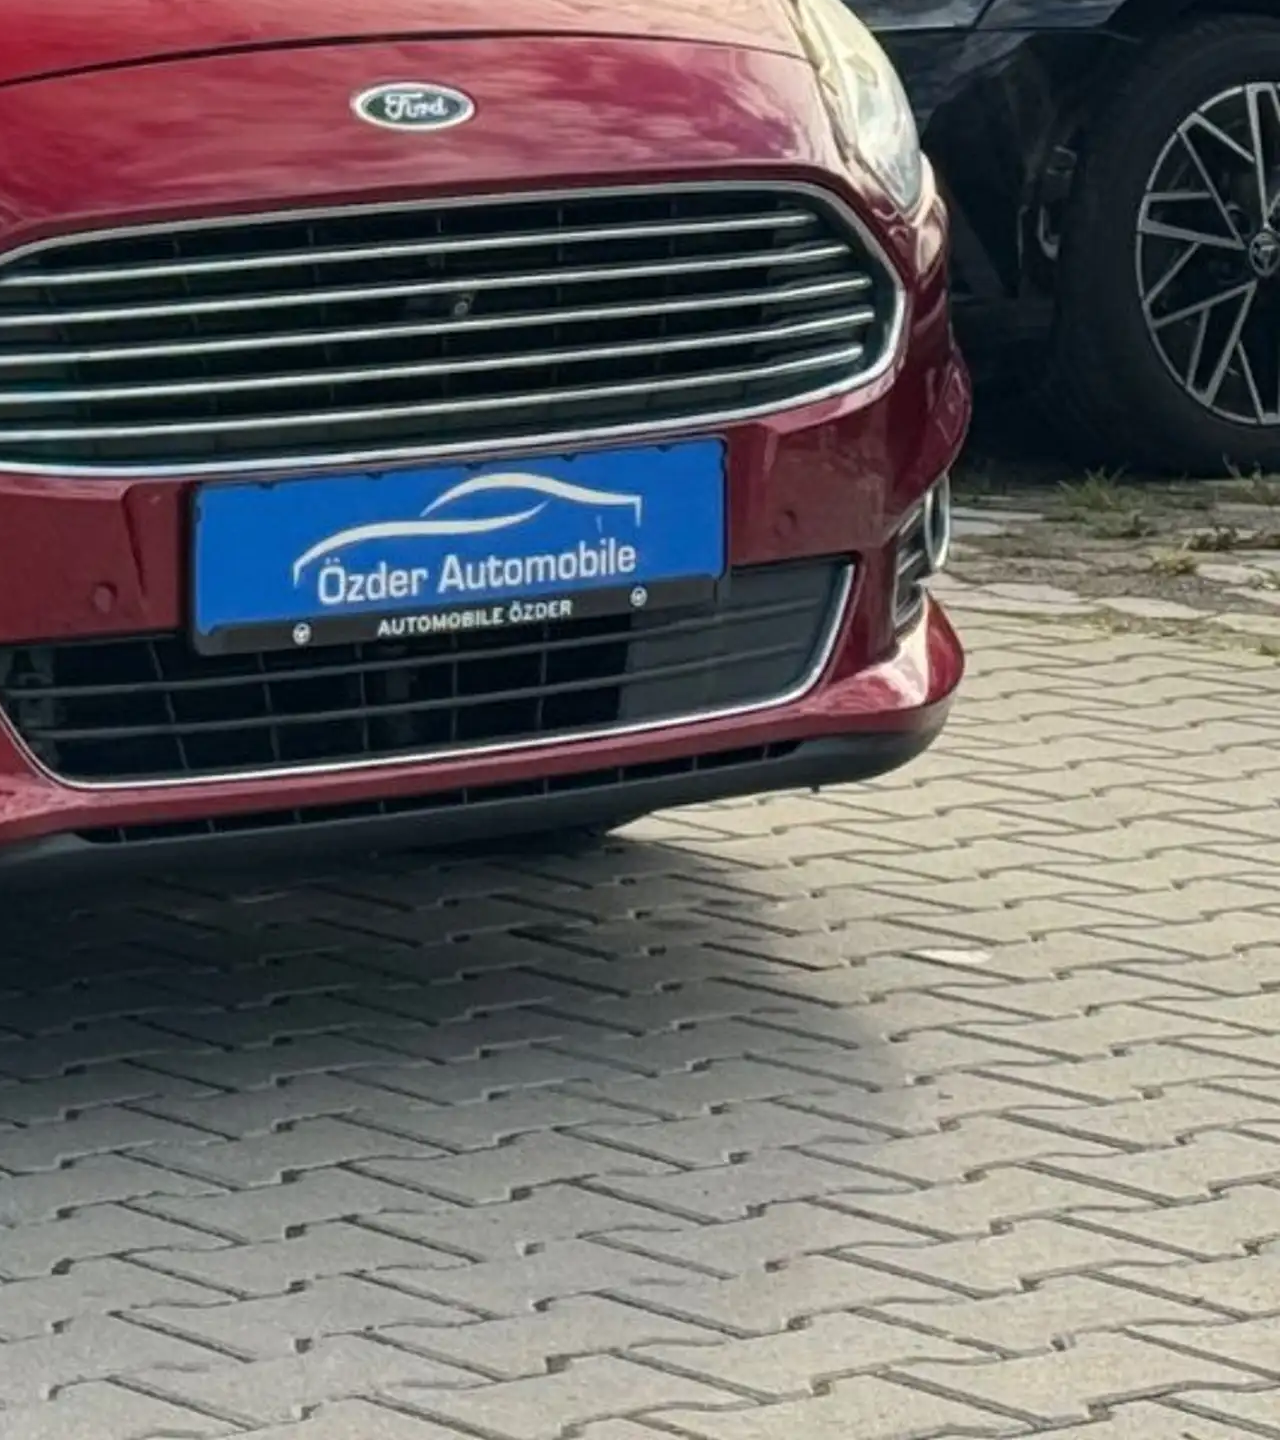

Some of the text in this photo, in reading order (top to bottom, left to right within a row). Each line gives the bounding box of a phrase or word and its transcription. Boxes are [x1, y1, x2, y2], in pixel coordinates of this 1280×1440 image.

[383, 92, 448, 120] Ford
[318, 538, 636, 605] Özder Automobile
[377, 598, 572, 637] AUTOMOBILE ÖZDER
